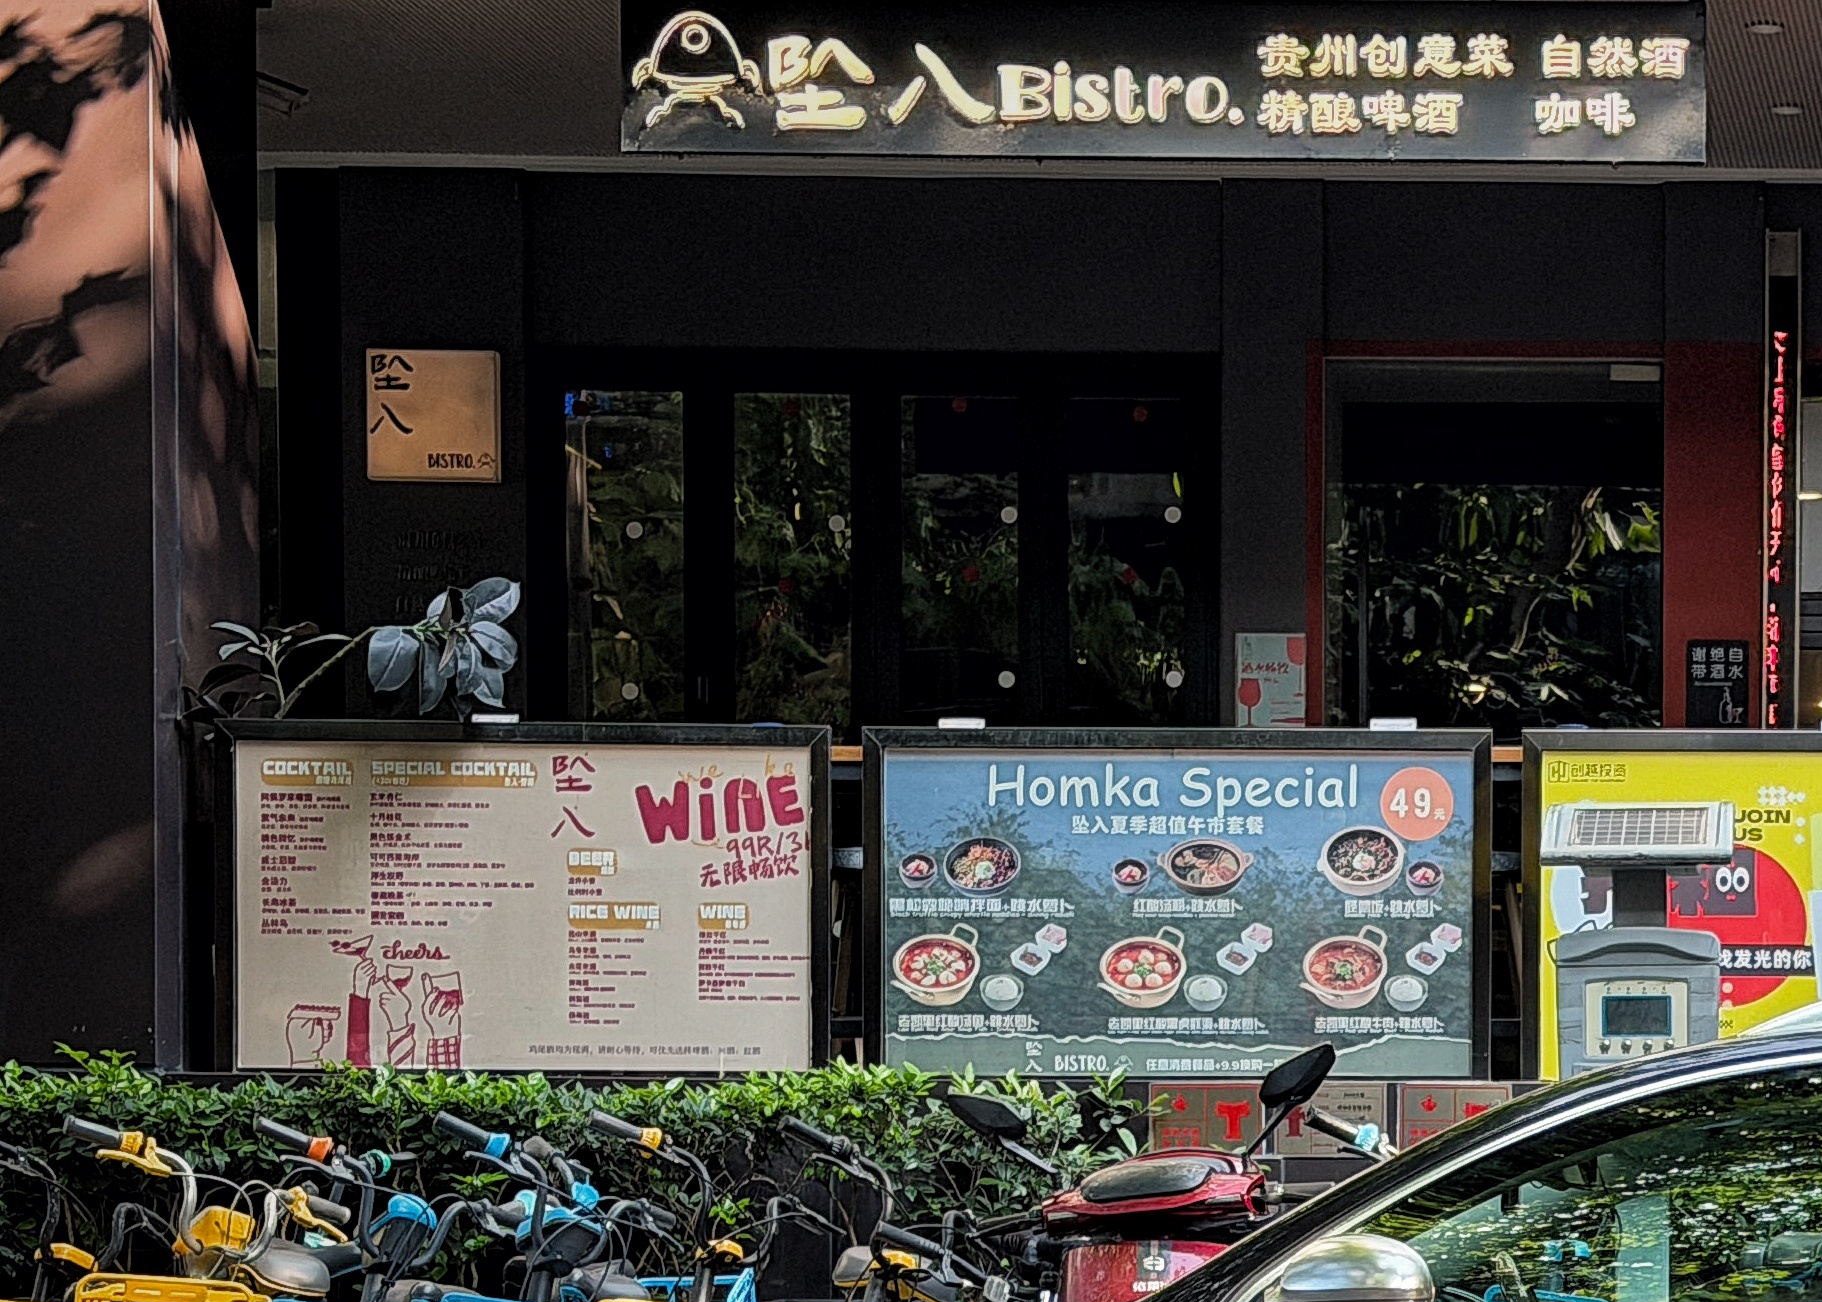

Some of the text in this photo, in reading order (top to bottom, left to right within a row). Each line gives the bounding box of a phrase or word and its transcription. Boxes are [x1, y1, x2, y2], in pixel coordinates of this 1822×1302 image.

[1257, 33, 1690, 79] 贵州创意菜 自然酒
[1257, 89, 1636, 136] 精酿啤酒 咖啡
[1690, 663, 1744, 679] 带酒水
[262, 761, 352, 776] COCKTAIL
[371, 761, 536, 776] SPECIAL COCKTAIL
[987, 763, 1358, 818] Homka Special
[1071, 815, 1265, 836] 坠入夏季超值午市套餐
[700, 854, 800, 888] 无限畅饮
[569, 904, 660, 919] RICE WINE
[700, 904, 746, 919] WINE
[381, 939, 451, 961] cheers
[1054, 1055, 1110, 1073] BISTRO.
